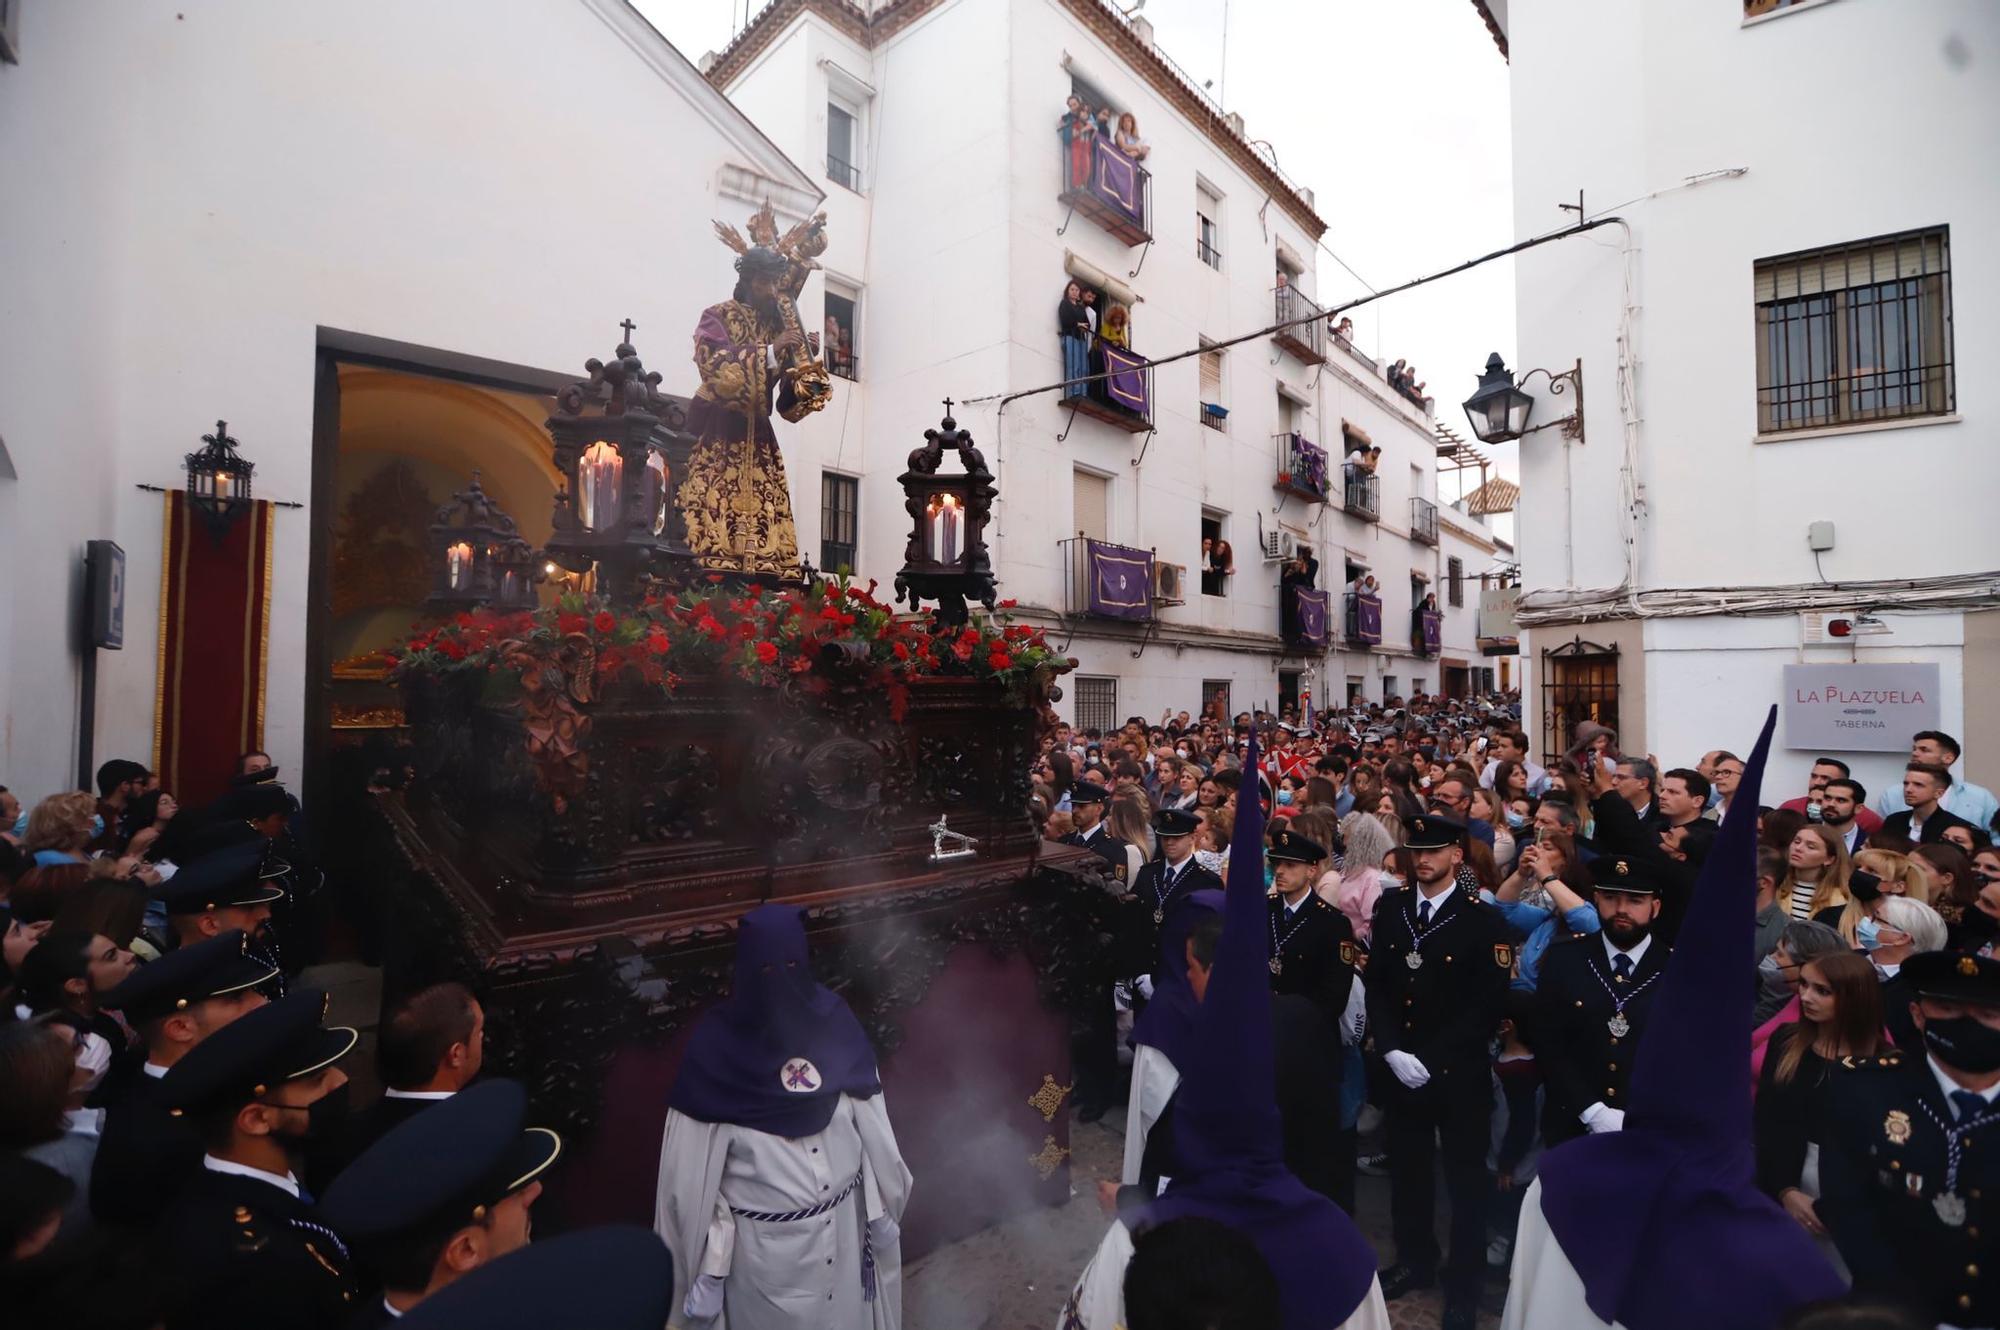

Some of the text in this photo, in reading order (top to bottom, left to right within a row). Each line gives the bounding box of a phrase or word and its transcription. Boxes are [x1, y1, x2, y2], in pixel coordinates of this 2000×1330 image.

[1796, 686, 1925, 704] LA PLAZUELA
[1835, 720, 1886, 729] TABERNA
